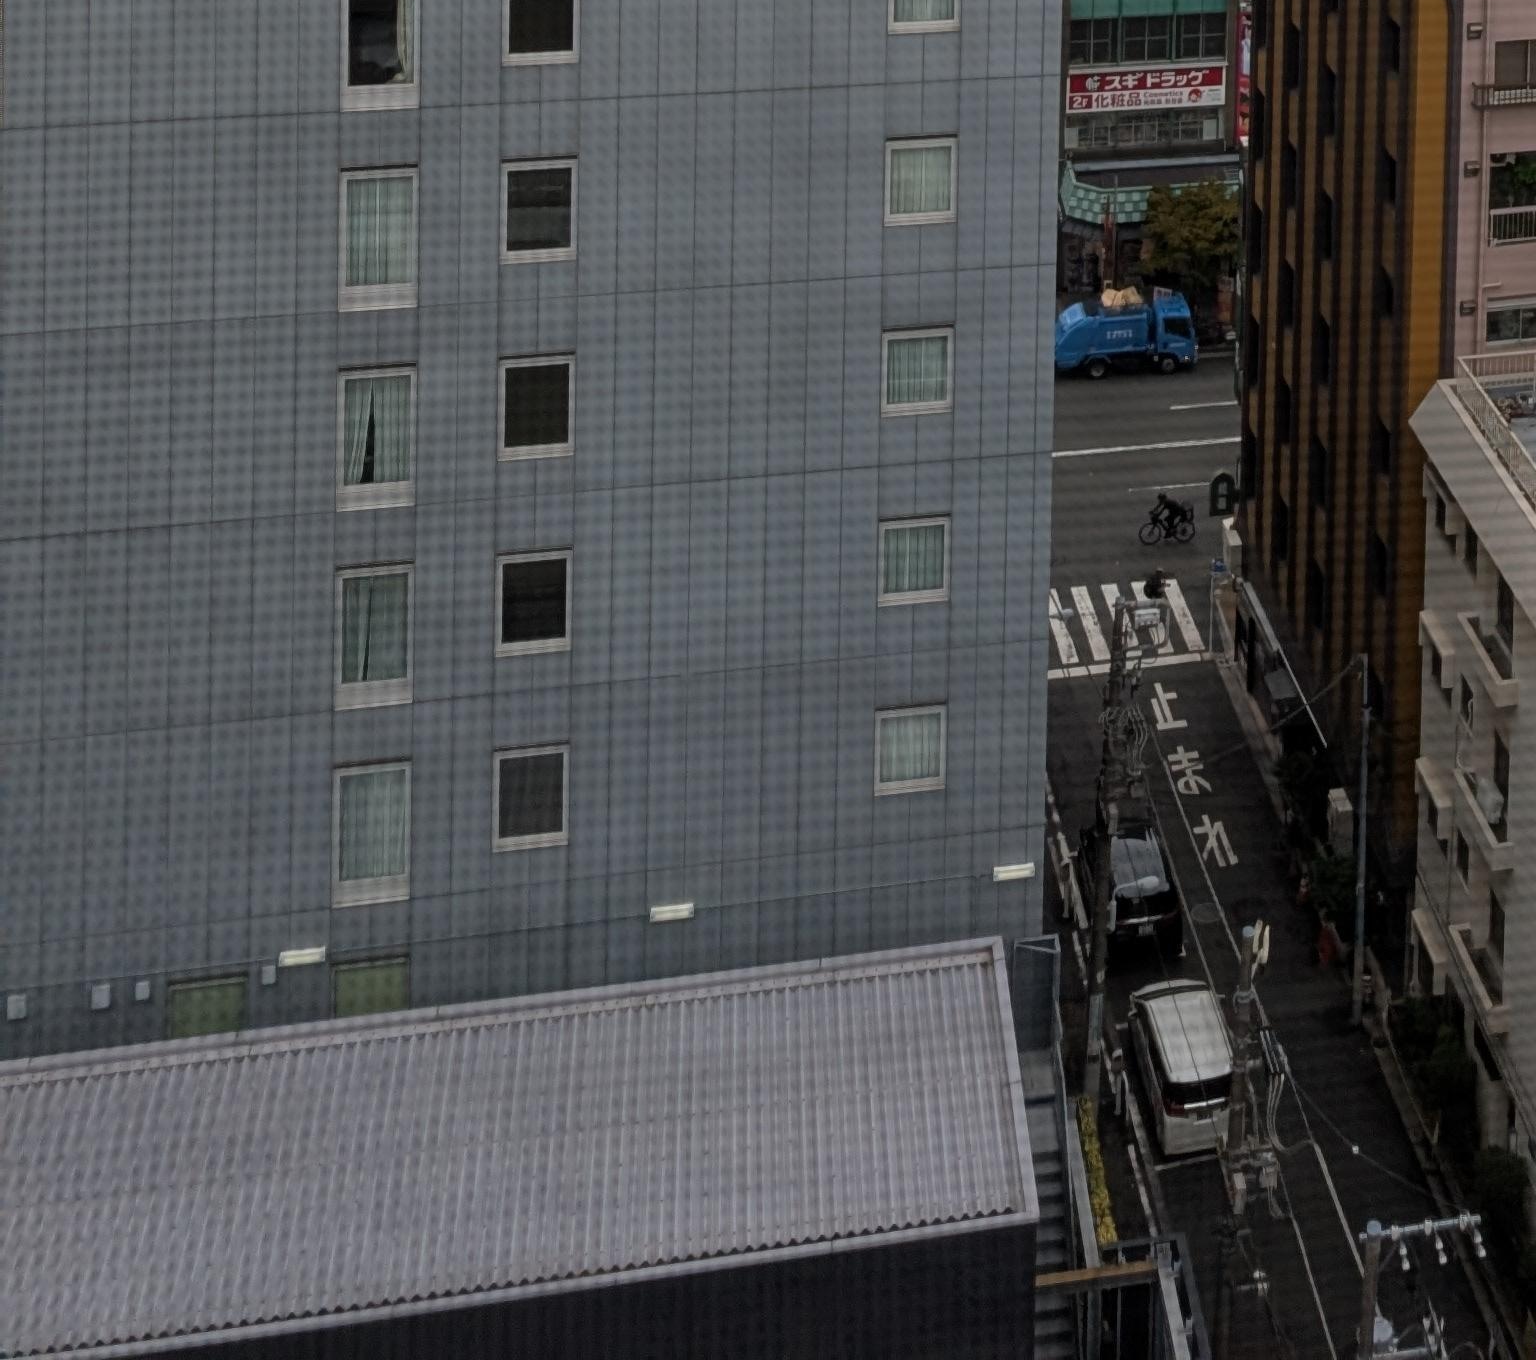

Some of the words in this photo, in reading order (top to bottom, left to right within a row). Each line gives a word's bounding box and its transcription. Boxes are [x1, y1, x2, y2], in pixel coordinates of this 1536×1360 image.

[1072, 96, 1089, 109] 2F
[1094, 92, 1142, 109] 化粧品
[1151, 682, 1239, 868] 止まれ
